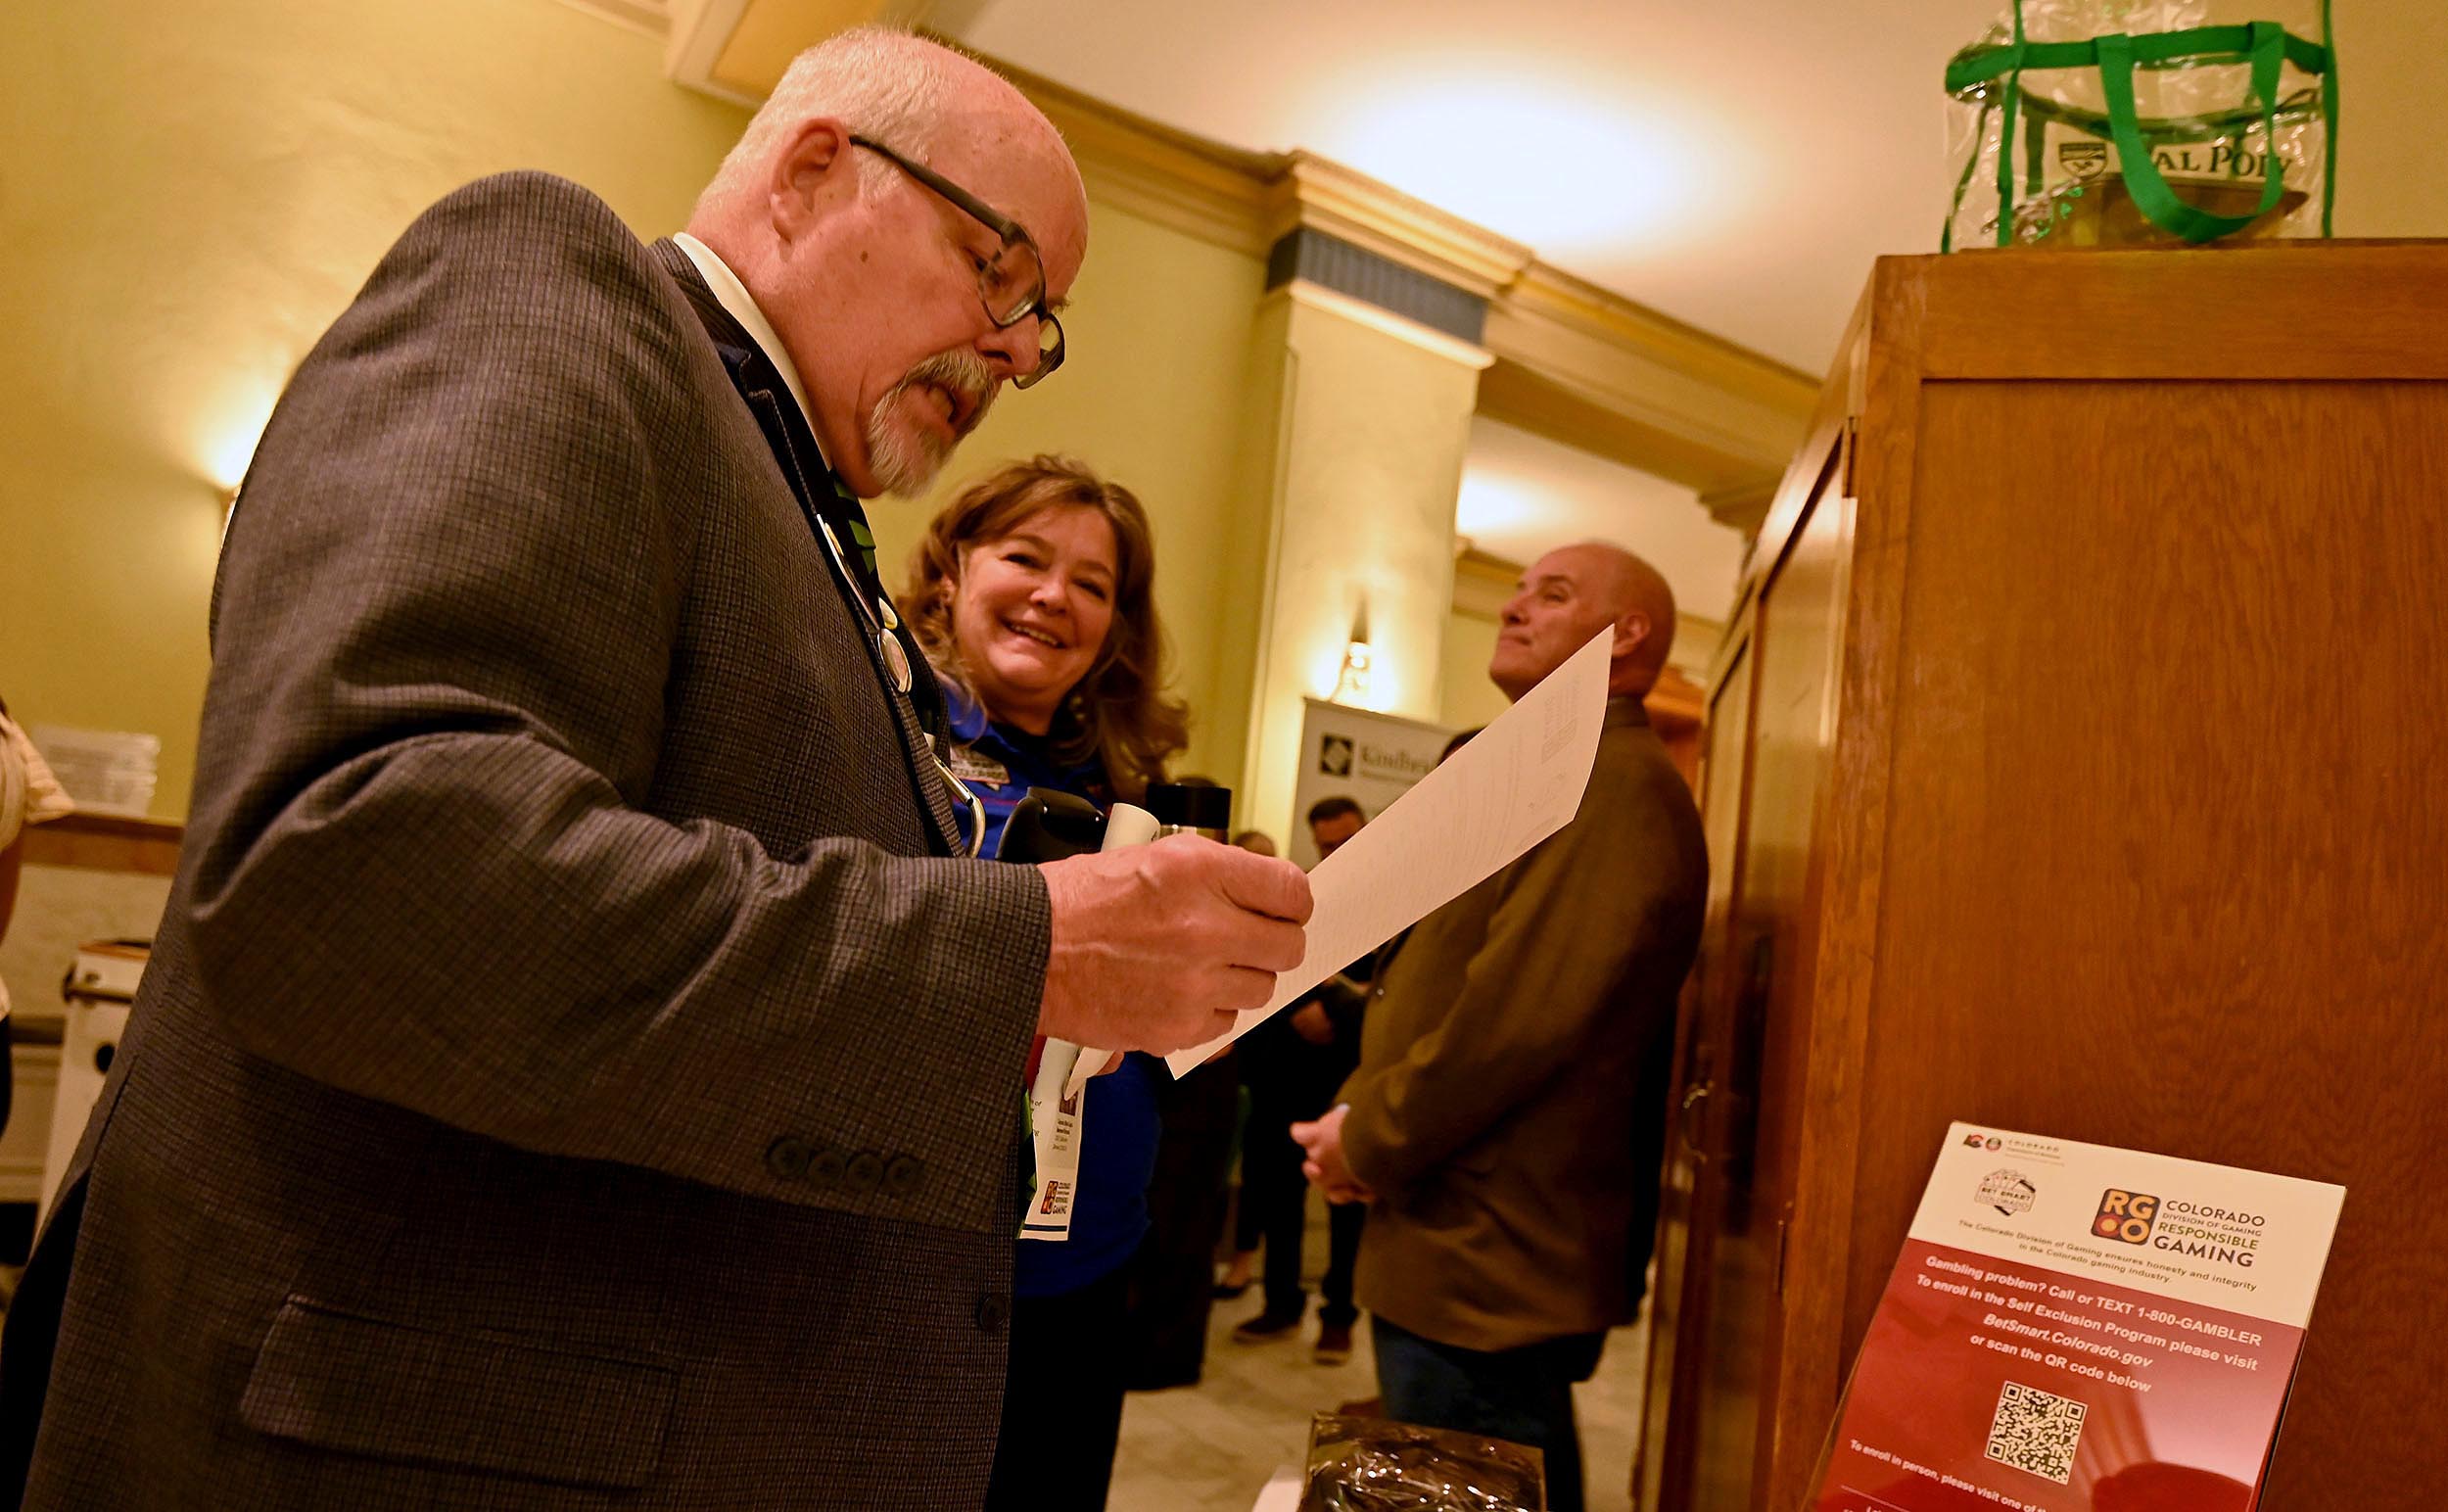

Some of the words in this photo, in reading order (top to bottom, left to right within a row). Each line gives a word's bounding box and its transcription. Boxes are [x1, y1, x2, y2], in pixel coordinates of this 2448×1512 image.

[2157, 1221, 2260, 1251] RESPONSIBLE
[2162, 1212, 2204, 1226] DIVISION
[2206, 1220, 2219, 1229] OF
[2222, 1223, 2262, 1237] GAMING
[2166, 1200, 2265, 1227] COLORADO
[1975, 1223, 2014, 1237] Colorado
[2016, 1232, 2052, 1245] Division
[2067, 1244, 2102, 1257] Gaming
[2105, 1252, 2143, 1266] ensures
[2146, 1260, 2188, 1276] honesty
[2189, 1269, 2210, 1281] and
[2212, 1274, 2257, 1293] integrity
[2030, 1245, 2044, 1253] the
[2046, 1249, 2089, 1263] Colorado
[2091, 1259, 2126, 1273] gaming
[2153, 1235, 2255, 1268] GAMING
[1917, 1273, 1932, 1288] To
[1932, 1280, 1969, 1297] enroll
[1969, 1288, 1983, 1301] in
[1984, 1292, 2005, 1306] the
[2006, 1297, 2036, 1313] Self
[2035, 1304, 2102, 1331] Exclusion
[2104, 1322, 2167, 1348] Program
[2169, 1340, 2220, 1361] please
[2224, 1352, 2259, 1371] visit
[1925, 1254, 1984, 1281] Gambling
[1984, 1272, 2048, 1294] problem?
[2048, 1285, 2076, 1301] Call
[2077, 1295, 2094, 1305] or
[2096, 1296, 2135, 1315] TEXT
[2138, 1306, 2264, 1347] 1-800-GAMBLER
[1969, 1334, 1986, 1347] or
[1986, 1338, 2019, 1356] scan
[2020, 1347, 2044, 1362] the
[2045, 1353, 2068, 1370] QR
[2069, 1361, 2104, 1380] code
[2106, 1371, 2152, 1393] below
[1982, 1313, 2154, 1368] BetSmart.Colorado.gov
[1850, 1439, 1862, 1451] To
[1862, 1445, 1891, 1462] enroll
[1892, 1454, 1903, 1466] in
[1902, 1460, 1940, 1482] person,
[1941, 1474, 1976, 1493] please
[1976, 1486, 2001, 1502] visit
[2001, 1496, 2022, 1510] one
